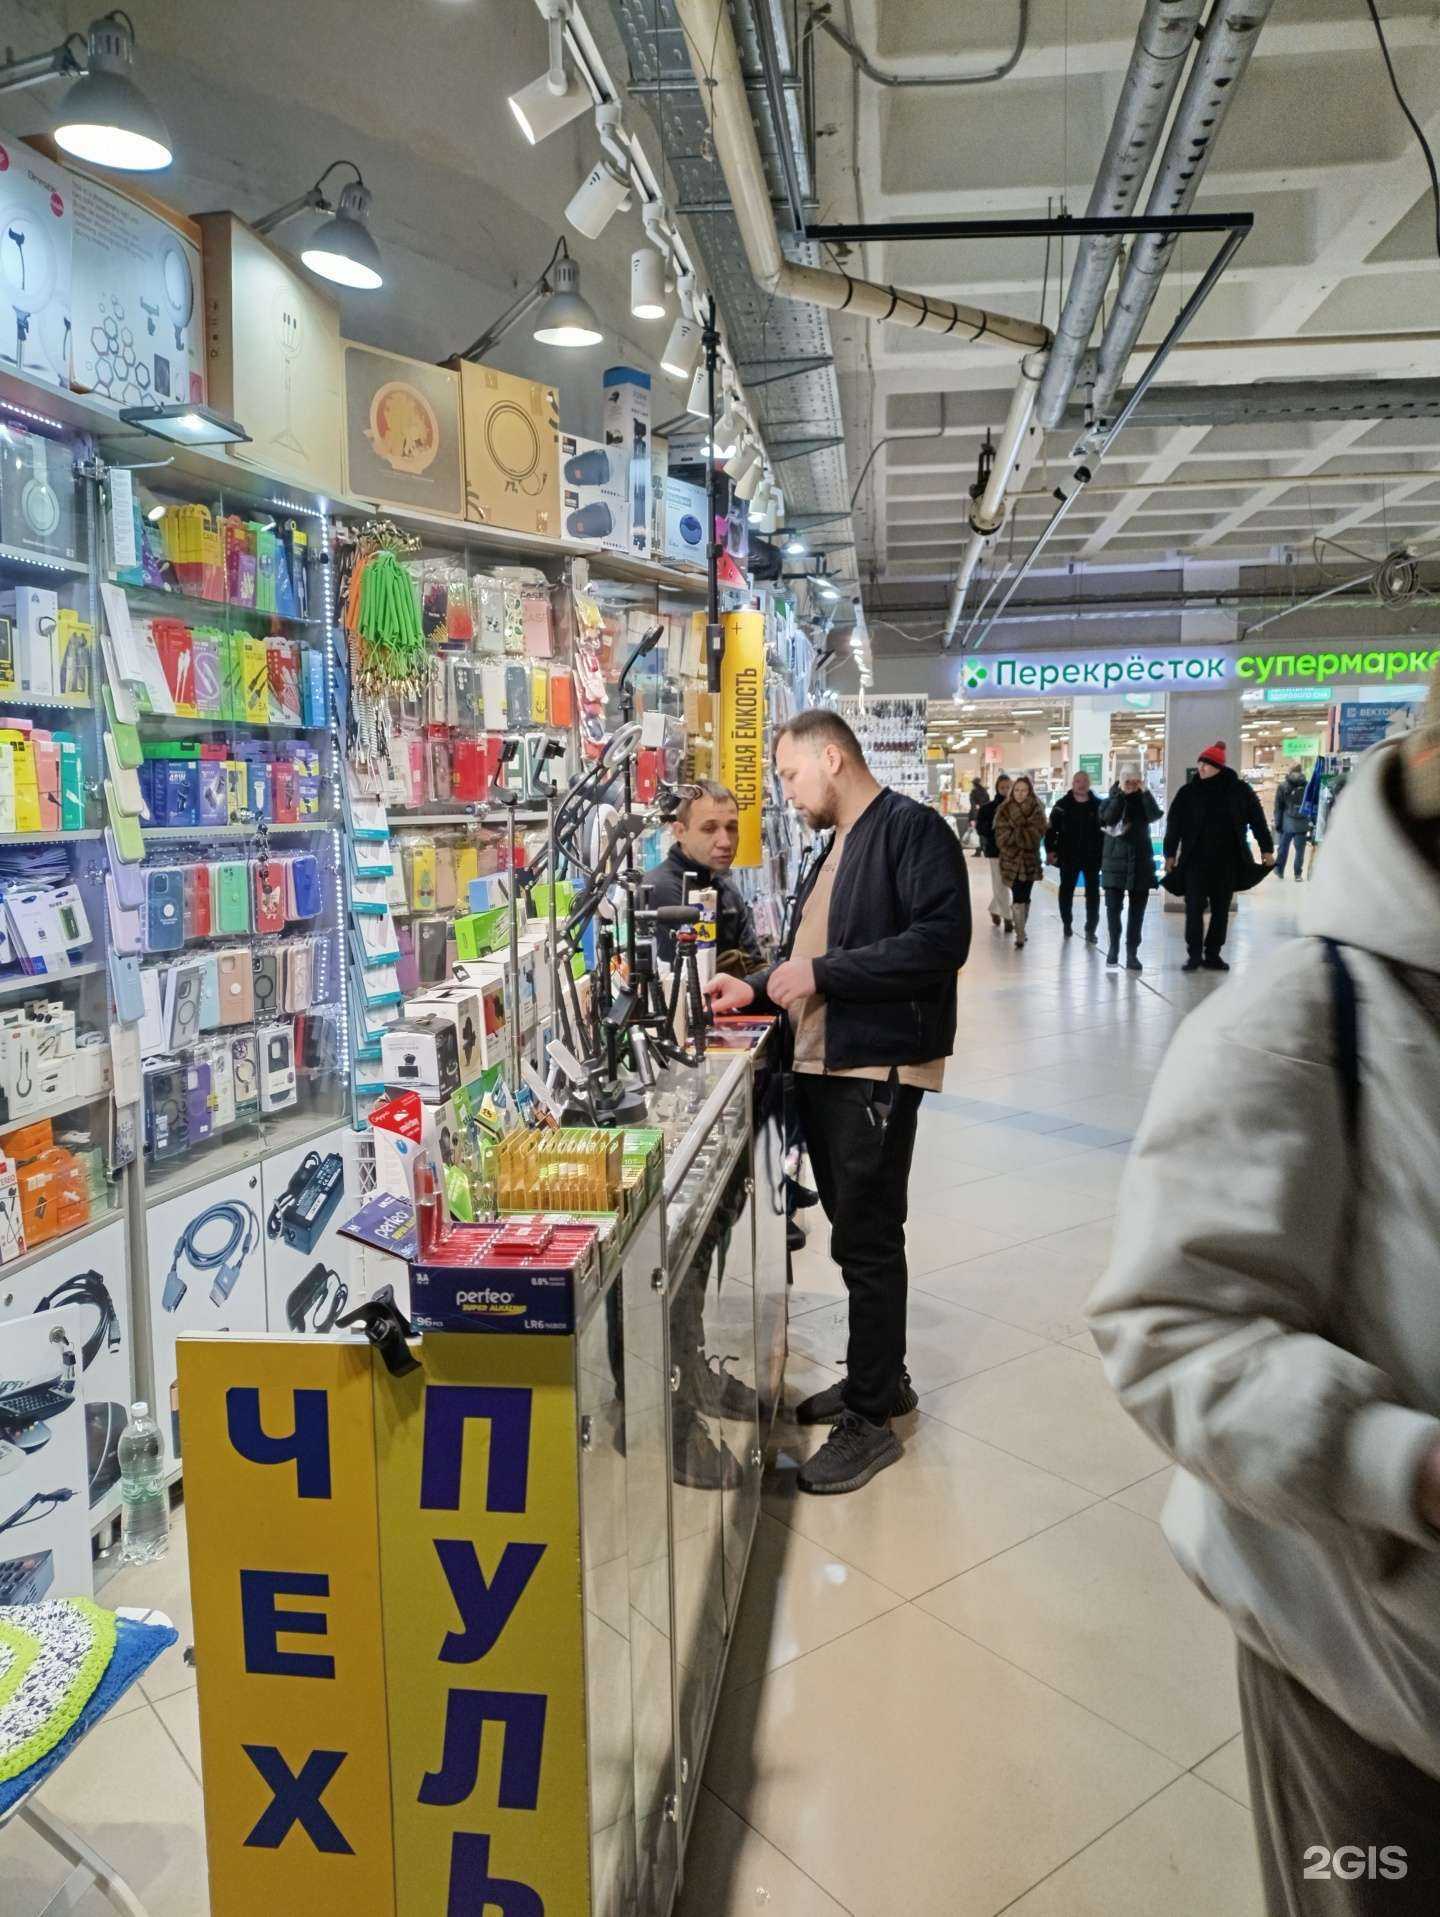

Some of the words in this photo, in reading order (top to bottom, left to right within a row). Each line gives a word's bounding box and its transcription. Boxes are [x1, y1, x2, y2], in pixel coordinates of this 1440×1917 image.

[997, 655, 1225, 690] Перекрёсток
[735, 745, 757, 812] ЧЕСТНАЯ
[374, 1210, 410, 1240] perfeo
[456, 1287, 512, 1305] perfeo
[416, 1316, 432, 1326] 96
[524, 1320, 544, 1329] LR6
